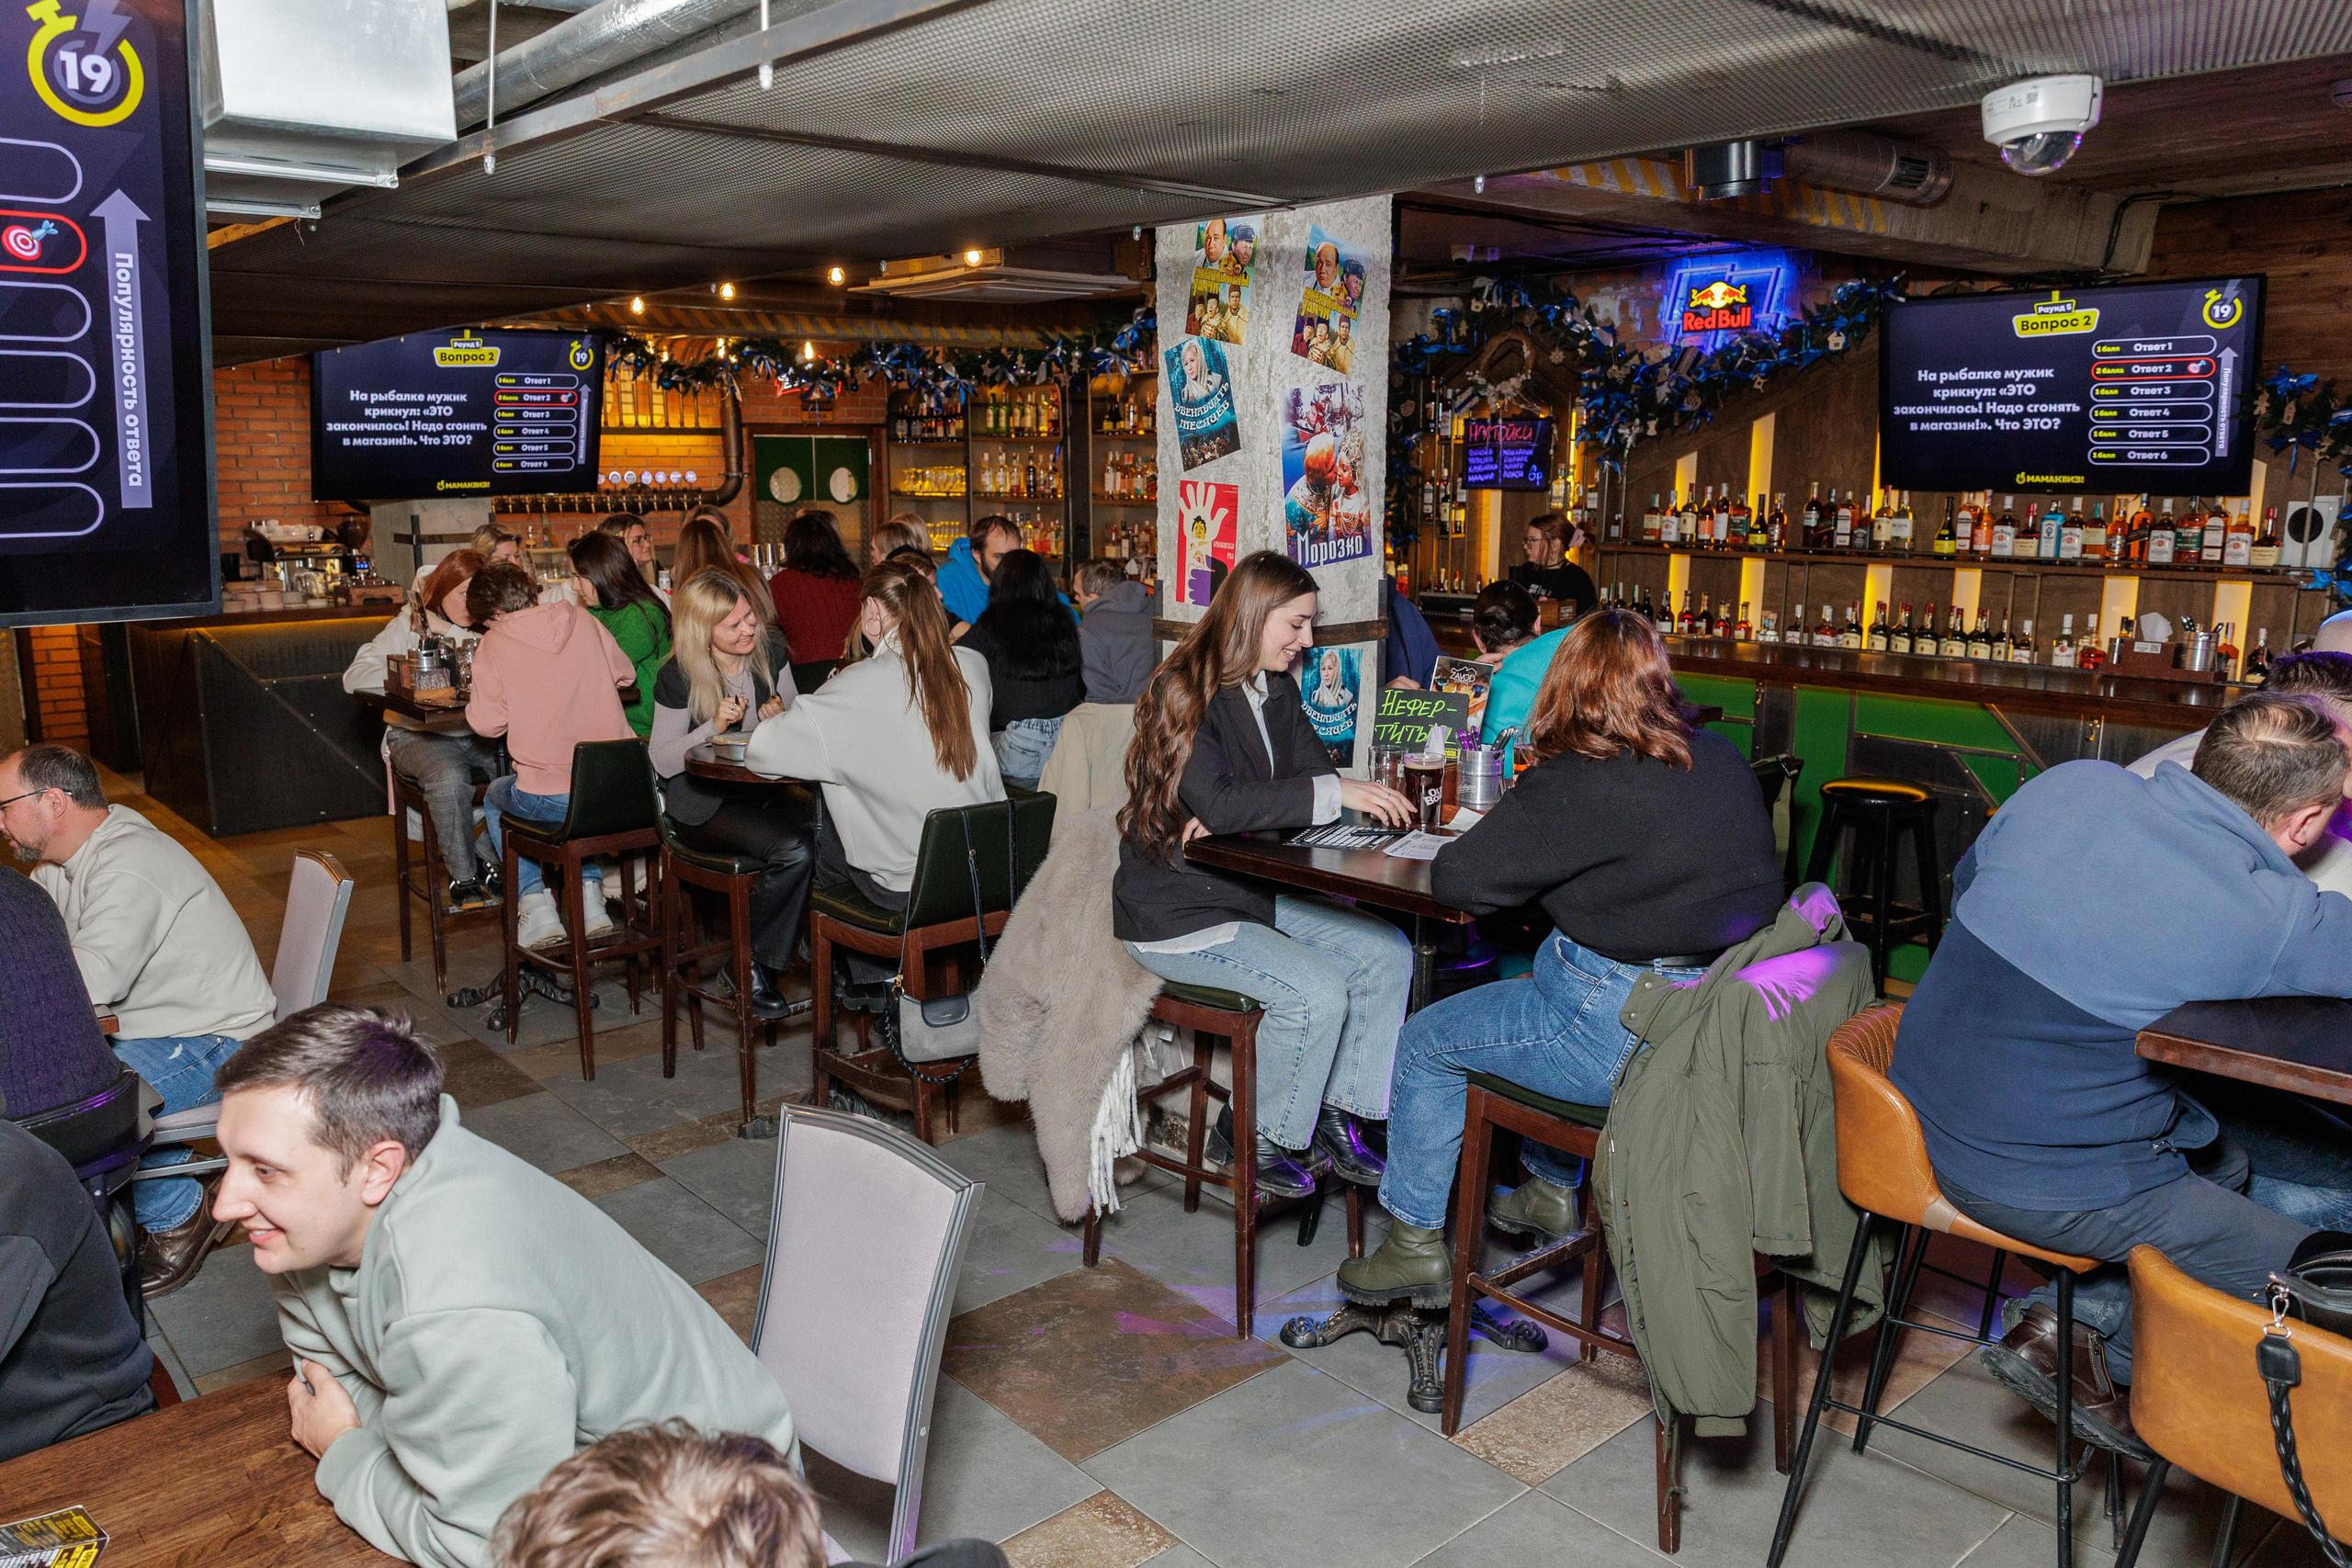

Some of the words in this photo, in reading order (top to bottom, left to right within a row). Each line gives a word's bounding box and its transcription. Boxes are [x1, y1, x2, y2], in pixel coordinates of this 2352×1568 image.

[59, 50, 113, 94] 19
[1193, 278, 1219, 296] УДАЧИ
[1301, 297, 1330, 321] УДАЧИ
[2038, 304, 2064, 315] Раунд
[2065, 303, 2073, 312] 5
[2212, 304, 2232, 319] 19
[1683, 310, 1716, 332] Red
[1717, 306, 1752, 329] Bull
[2020, 318, 2079, 333] Вопрос
[2083, 315, 2091, 327] 2
[113, 252, 137, 411] Популярность
[2133, 344, 2166, 352] Ответ
[2167, 343, 2173, 351] 1
[440, 353, 485, 364] Вопрос
[489, 352, 494, 361] 2
[575, 352, 587, 363] 19
[1917, 369, 1937, 381] На
[1939, 367, 2001, 384] рыбалке
[2004, 368, 2054, 382] мужик
[2165, 365, 2172, 373] 2
[350, 390, 368, 401] На
[370, 389, 424, 404] рыбалке
[426, 393, 468, 404] мужик
[1933, 387, 1996, 400] крикнул:
[1998, 383, 2036, 396] «ЭТО
[2131, 387, 2163, 395] Ответ
[2164, 387, 2171, 395] 3
[2221, 367, 2231, 422] Популярность
[1174, 382, 1229, 418] ДВЕНАДЦАТЬ
[365, 408, 421, 419] крикнул:
[423, 406, 453, 416] «ЭТО
[1180, 400, 1230, 431] МЕСЯЦЕВ
[1894, 401, 1983, 415] закончилось!
[1985, 401, 2024, 415] Надо
[2026, 403, 2081, 413] сгонять
[2162, 408, 2170, 416] 4
[326, 422, 409, 432] закончилось!
[412, 421, 443, 433] Надо
[445, 423, 488, 431] сгонять
[1909, 423, 1918, 431] в
[1919, 418, 1992, 431] магазин!».
[1994, 418, 2020, 430] Что
[2022, 417, 2061, 430] ЭТО?
[343, 437, 351, 446] в
[353, 435, 417, 446] магазин!».
[419, 435, 441, 446] Что
[442, 434, 472, 446] ЭТО?
[2128, 430, 2161, 438] Ответ
[2162, 430, 2168, 438] 5
[123, 413, 142, 488] ответа
[2127, 451, 2159, 459] Ответ
[2161, 451, 2168, 459] 6
[446, 481, 490, 490] МАМАКВИЗ!
[2027, 475, 2085, 484] МАМАКВИЗ!
[1296, 529, 1363, 566] Морозко
[1450, 671, 1476, 682] ZAVOD
[1378, 690, 1457, 717] НЕФЕР-
[1301, 700, 1358, 723] ДВЕНАДЦАТЬ
[1310, 718, 1354, 735] ЕСЯЦЕВ
